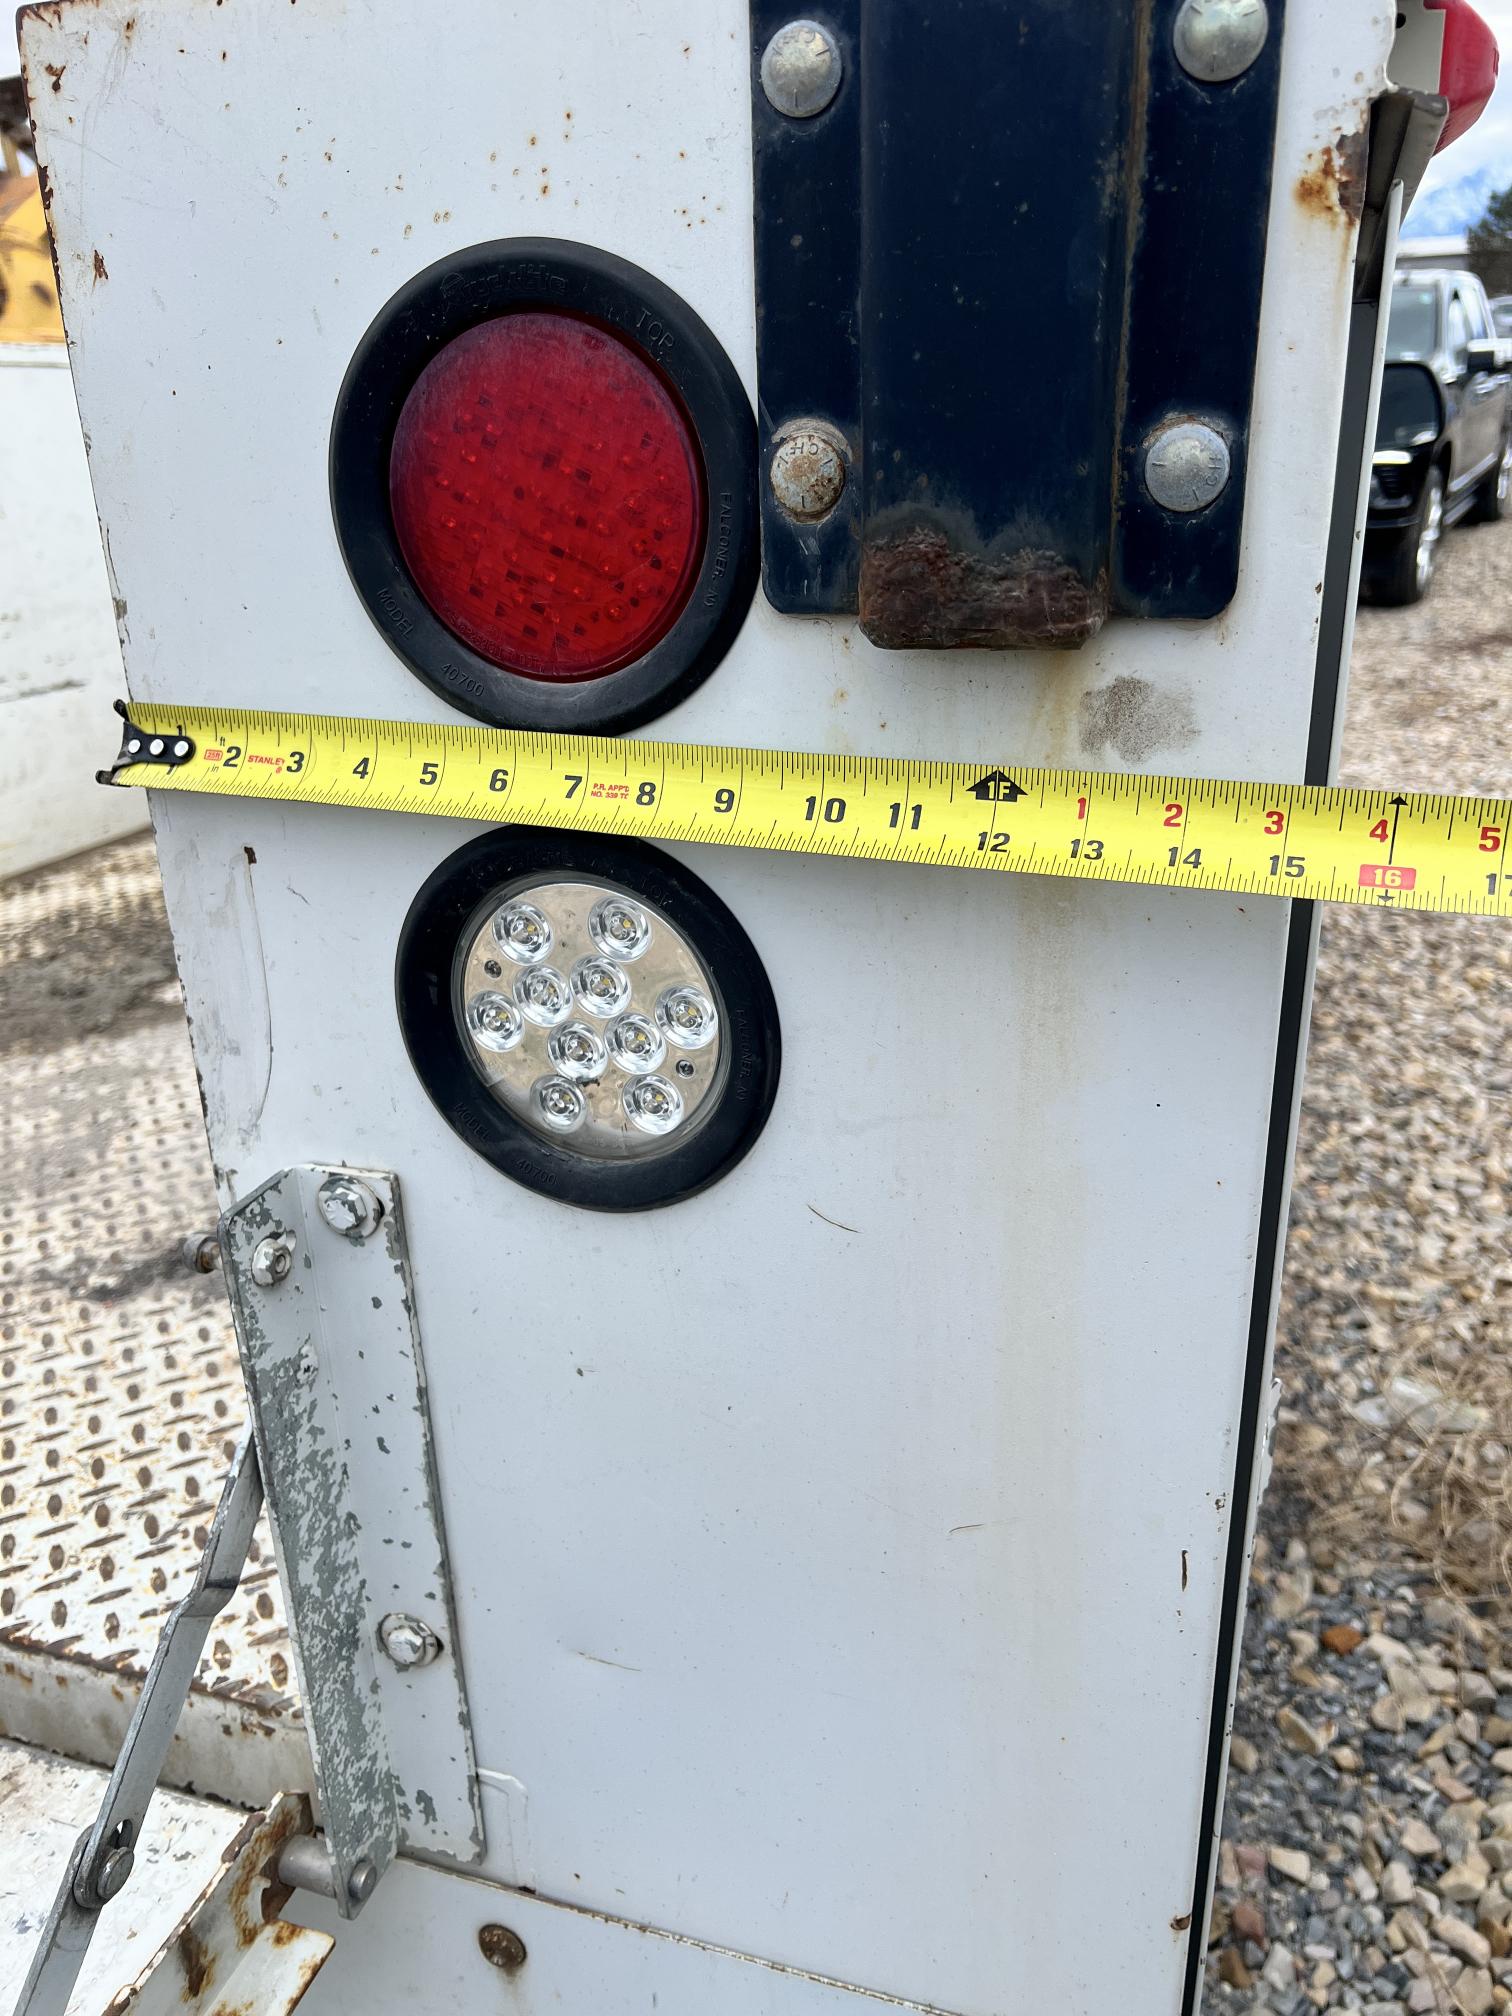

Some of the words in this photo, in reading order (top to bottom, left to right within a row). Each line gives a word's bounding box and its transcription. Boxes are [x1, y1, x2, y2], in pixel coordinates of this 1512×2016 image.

[636, 308, 674, 346] TOP
[377, 587, 414, 640] MODEL
[441, 663, 485, 697] 40700
[222, 746, 242, 768] 2
[286, 751, 305, 773] 3
[352, 757, 370, 780] 4
[419, 762, 439, 786] 5
[489, 768, 509, 792] 6
[564, 774, 583, 799] 7
[635, 781, 657, 806] 8
[713, 788, 735, 813] 9
[805, 795, 847, 823] 10
[889, 802, 923, 830] 11
[977, 831, 1011, 853] 12
[1070, 838, 1104, 860] 13
[1168, 846, 1202, 869] 14
[1269, 854, 1306, 878] 15
[1373, 869, 1402, 887] 16
[1077, 797, 1086, 820] 1
[1163, 803, 1184, 828] 2
[1263, 811, 1285, 835] 3
[1369, 819, 1389, 843] 4
[1478, 826, 1501, 852] 5
